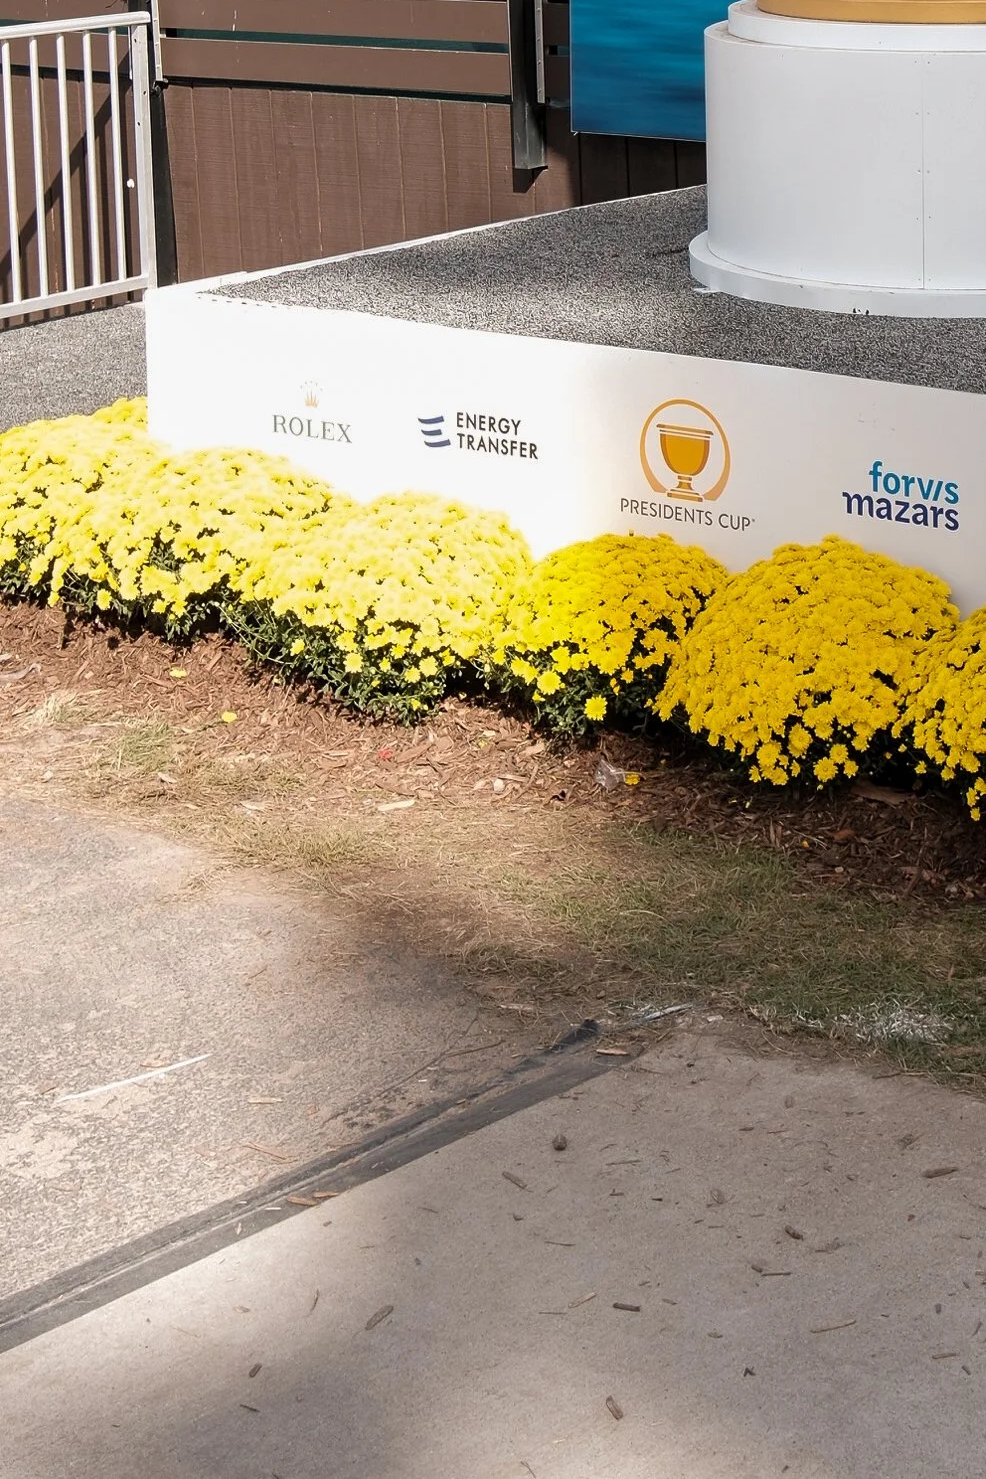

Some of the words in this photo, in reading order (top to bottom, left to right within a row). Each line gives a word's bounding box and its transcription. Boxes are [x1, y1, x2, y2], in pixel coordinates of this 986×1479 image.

[272, 414, 353, 443] ROLEX
[456, 411, 522, 436] ENERGY
[456, 433, 538, 460] TRANSFER
[868, 460, 959, 504] forvis
[620, 497, 713, 526] PRESIDENTS
[718, 513, 751, 531] CUP
[842, 491, 960, 531] mazars
